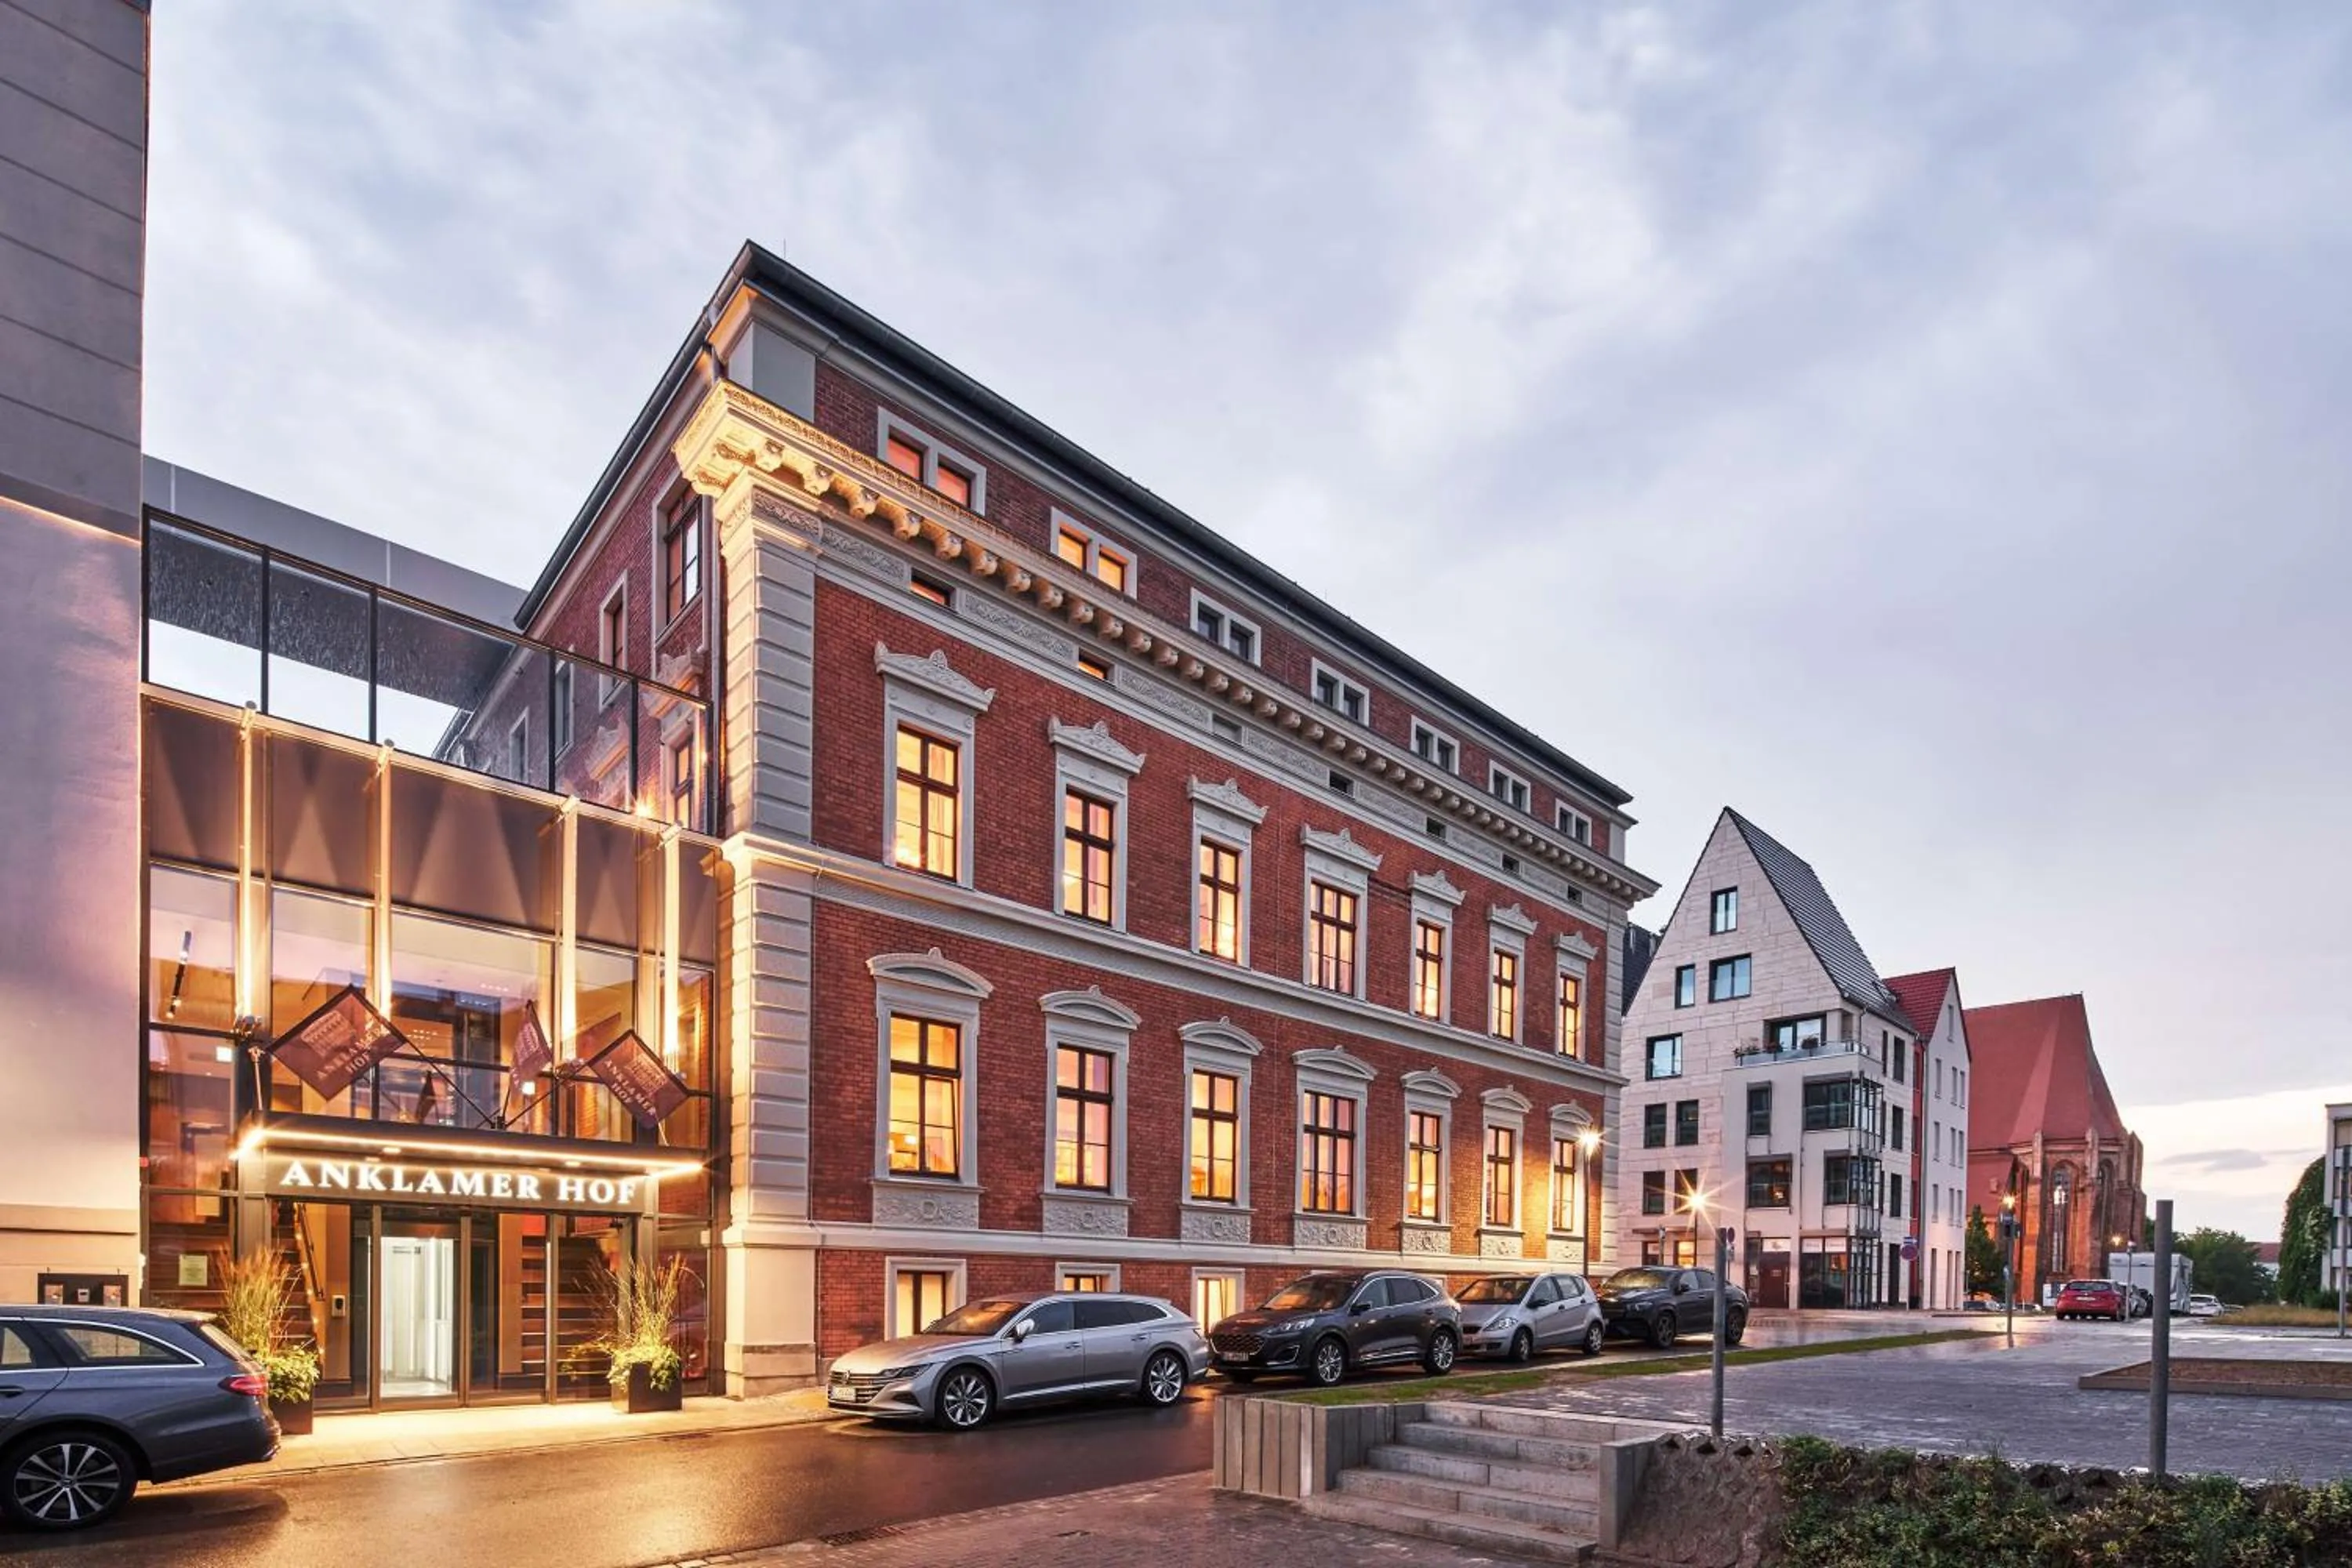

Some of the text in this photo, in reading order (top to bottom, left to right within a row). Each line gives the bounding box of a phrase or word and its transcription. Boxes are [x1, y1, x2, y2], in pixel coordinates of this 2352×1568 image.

[345, 1052, 370, 1073] HOF
[603, 1059, 656, 1115] ANKLAMER
[612, 1082, 633, 1103] HOF
[279, 1160, 639, 1205] ANKLAMER HOF
